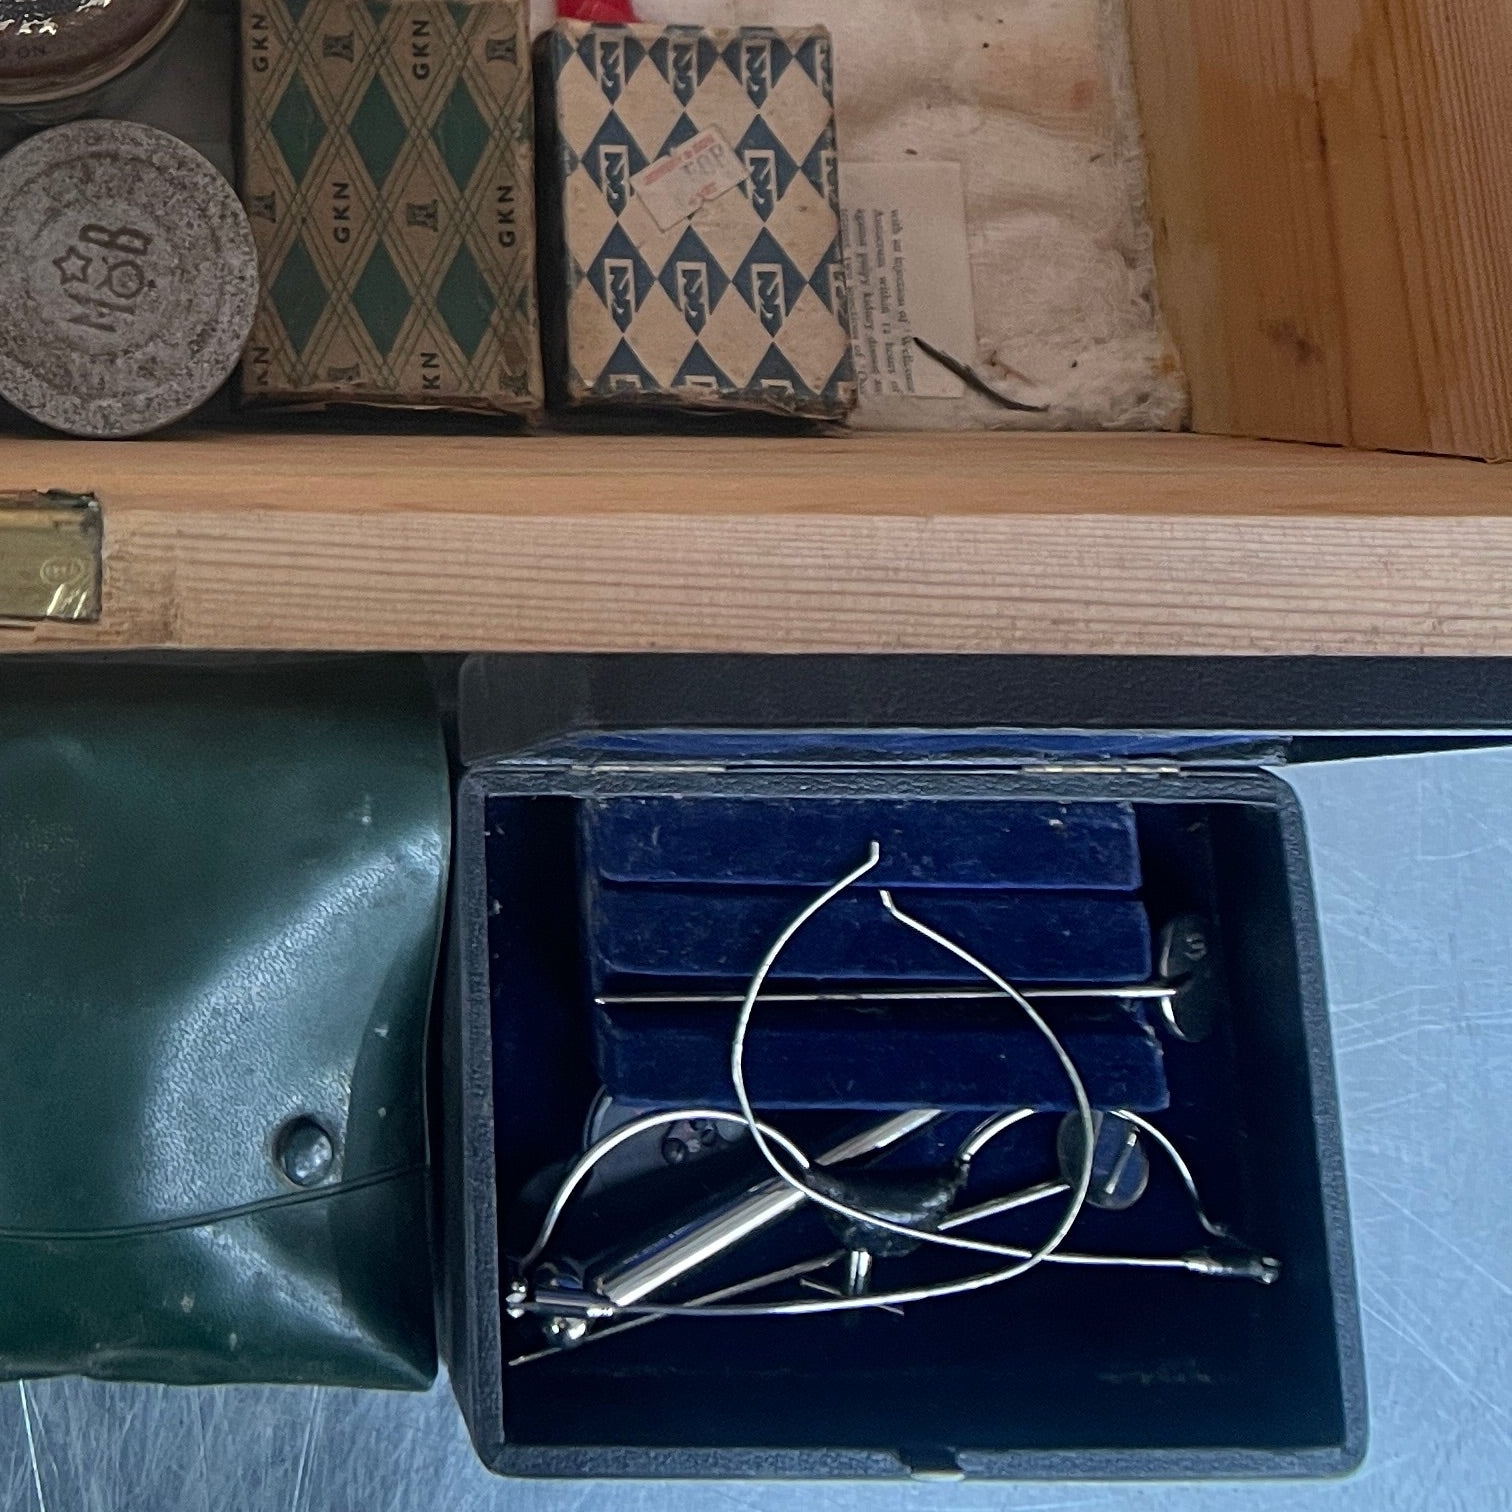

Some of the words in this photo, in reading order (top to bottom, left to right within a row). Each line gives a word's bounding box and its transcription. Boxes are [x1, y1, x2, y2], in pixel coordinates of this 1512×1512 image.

[252, 13, 268, 73] GKN
[413, 20, 431, 80] GKN
[333, 183, 350, 244] GKN
[499, 185, 516, 248] GKN
[422, 353, 441, 389] KN
